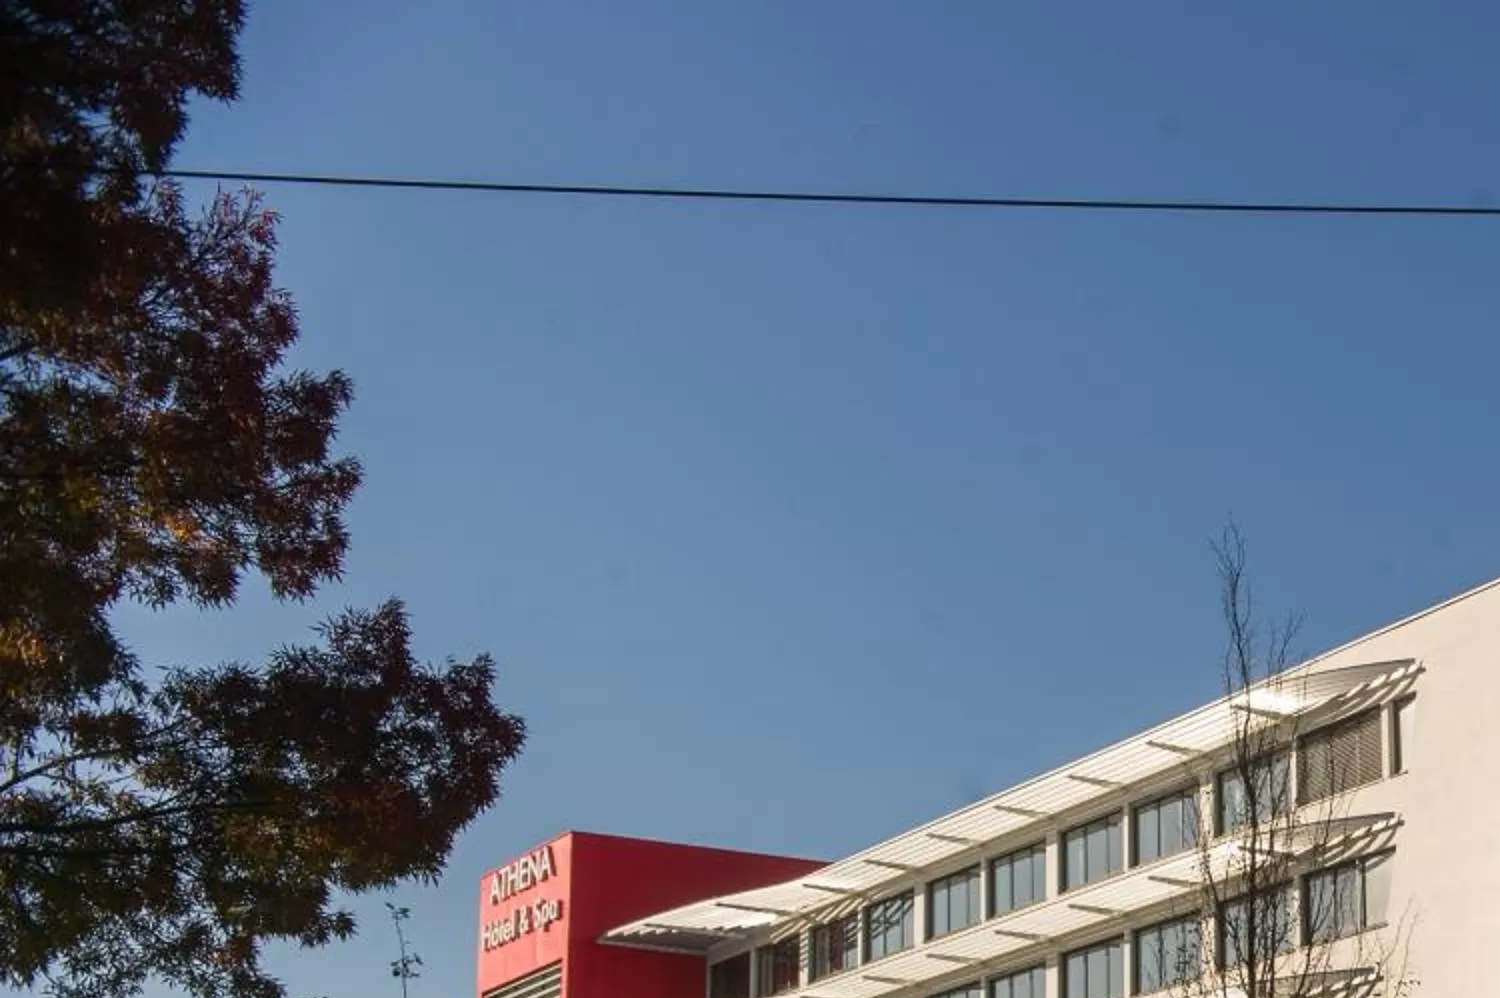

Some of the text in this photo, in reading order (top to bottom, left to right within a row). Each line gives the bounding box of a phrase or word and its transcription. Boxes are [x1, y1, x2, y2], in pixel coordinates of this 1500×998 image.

[489, 846, 555, 904] ATHENA
[481, 899, 562, 952] Hotel & Spa
